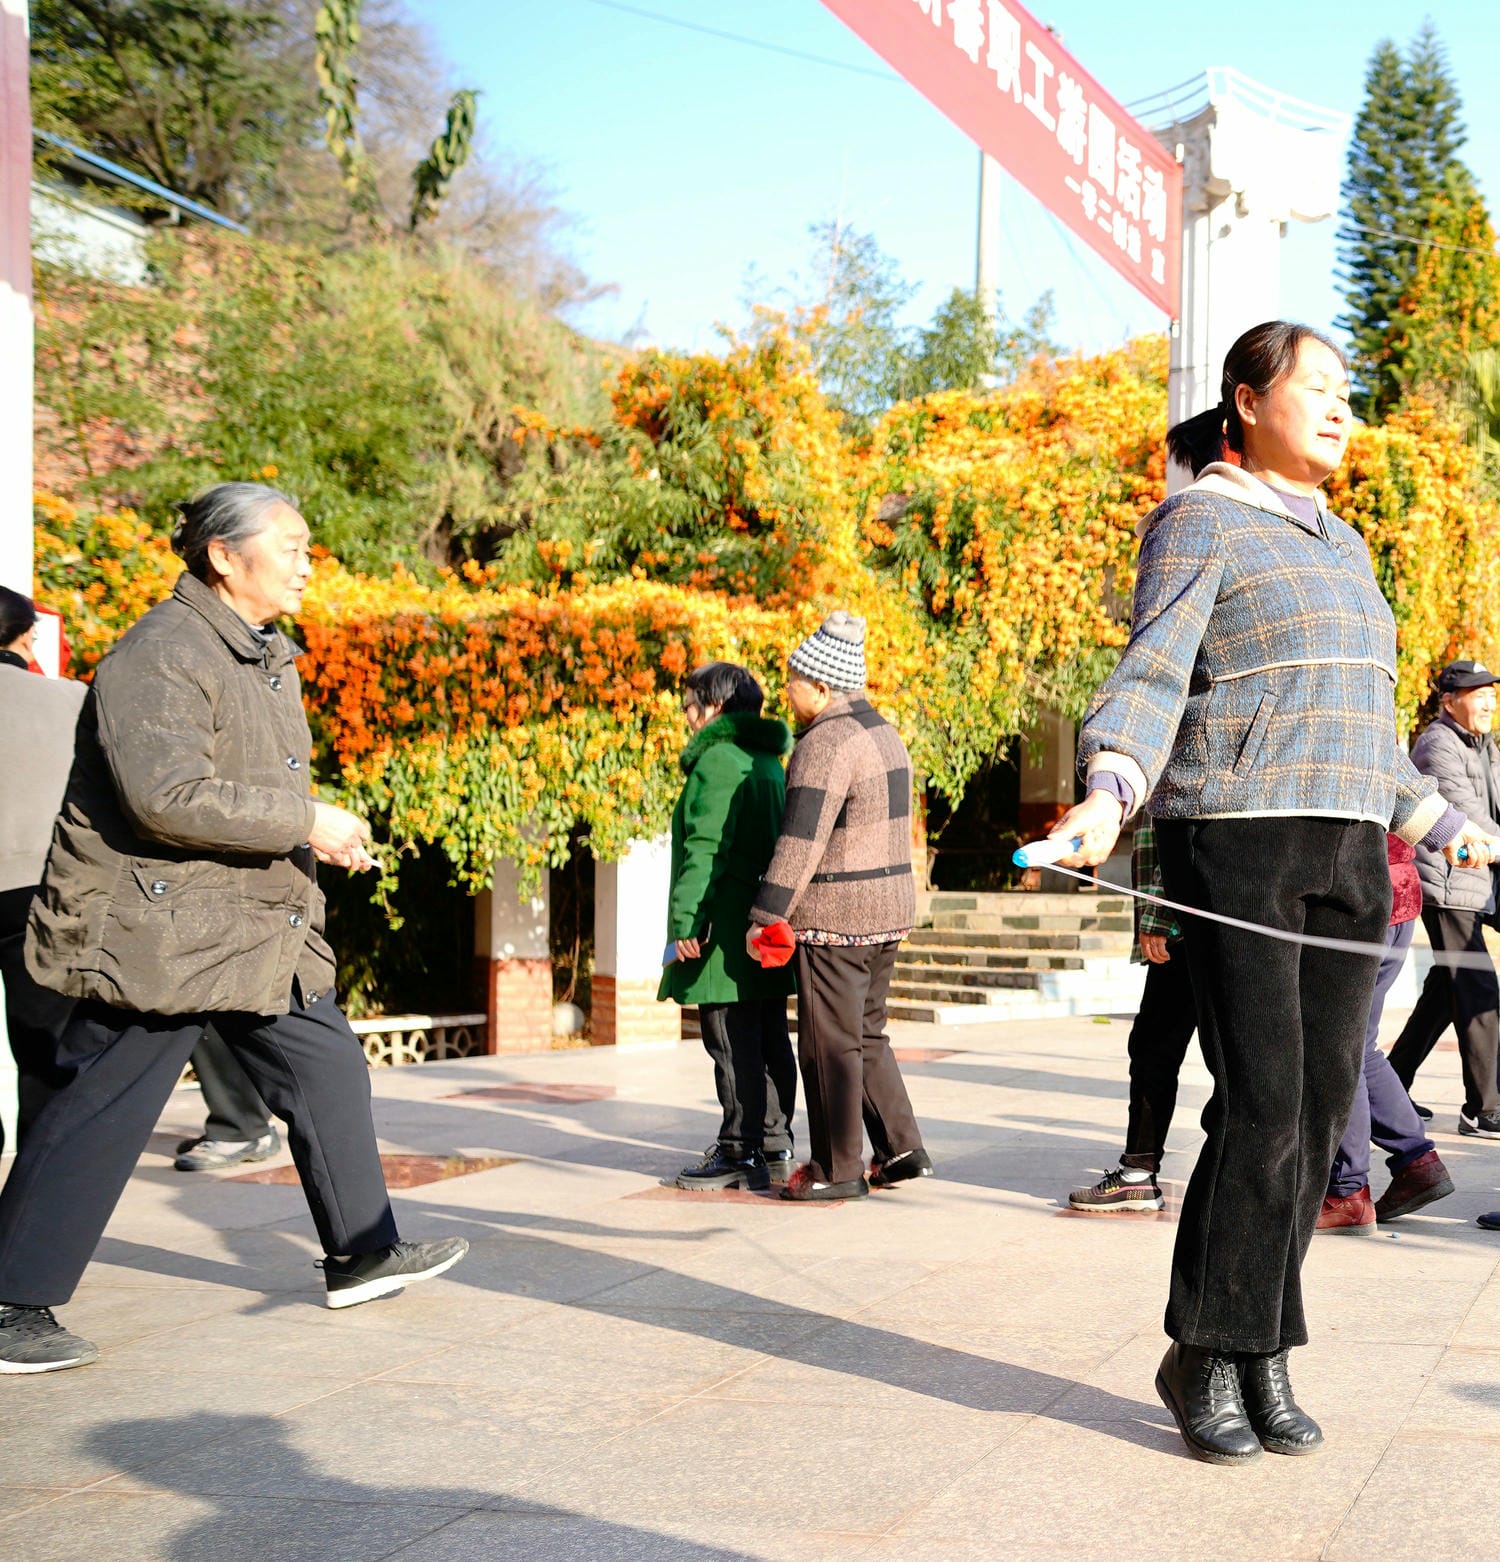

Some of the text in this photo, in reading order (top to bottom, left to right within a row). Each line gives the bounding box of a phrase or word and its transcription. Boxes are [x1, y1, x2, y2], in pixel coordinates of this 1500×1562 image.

[913, 0, 1167, 242] 春职工游园活动
